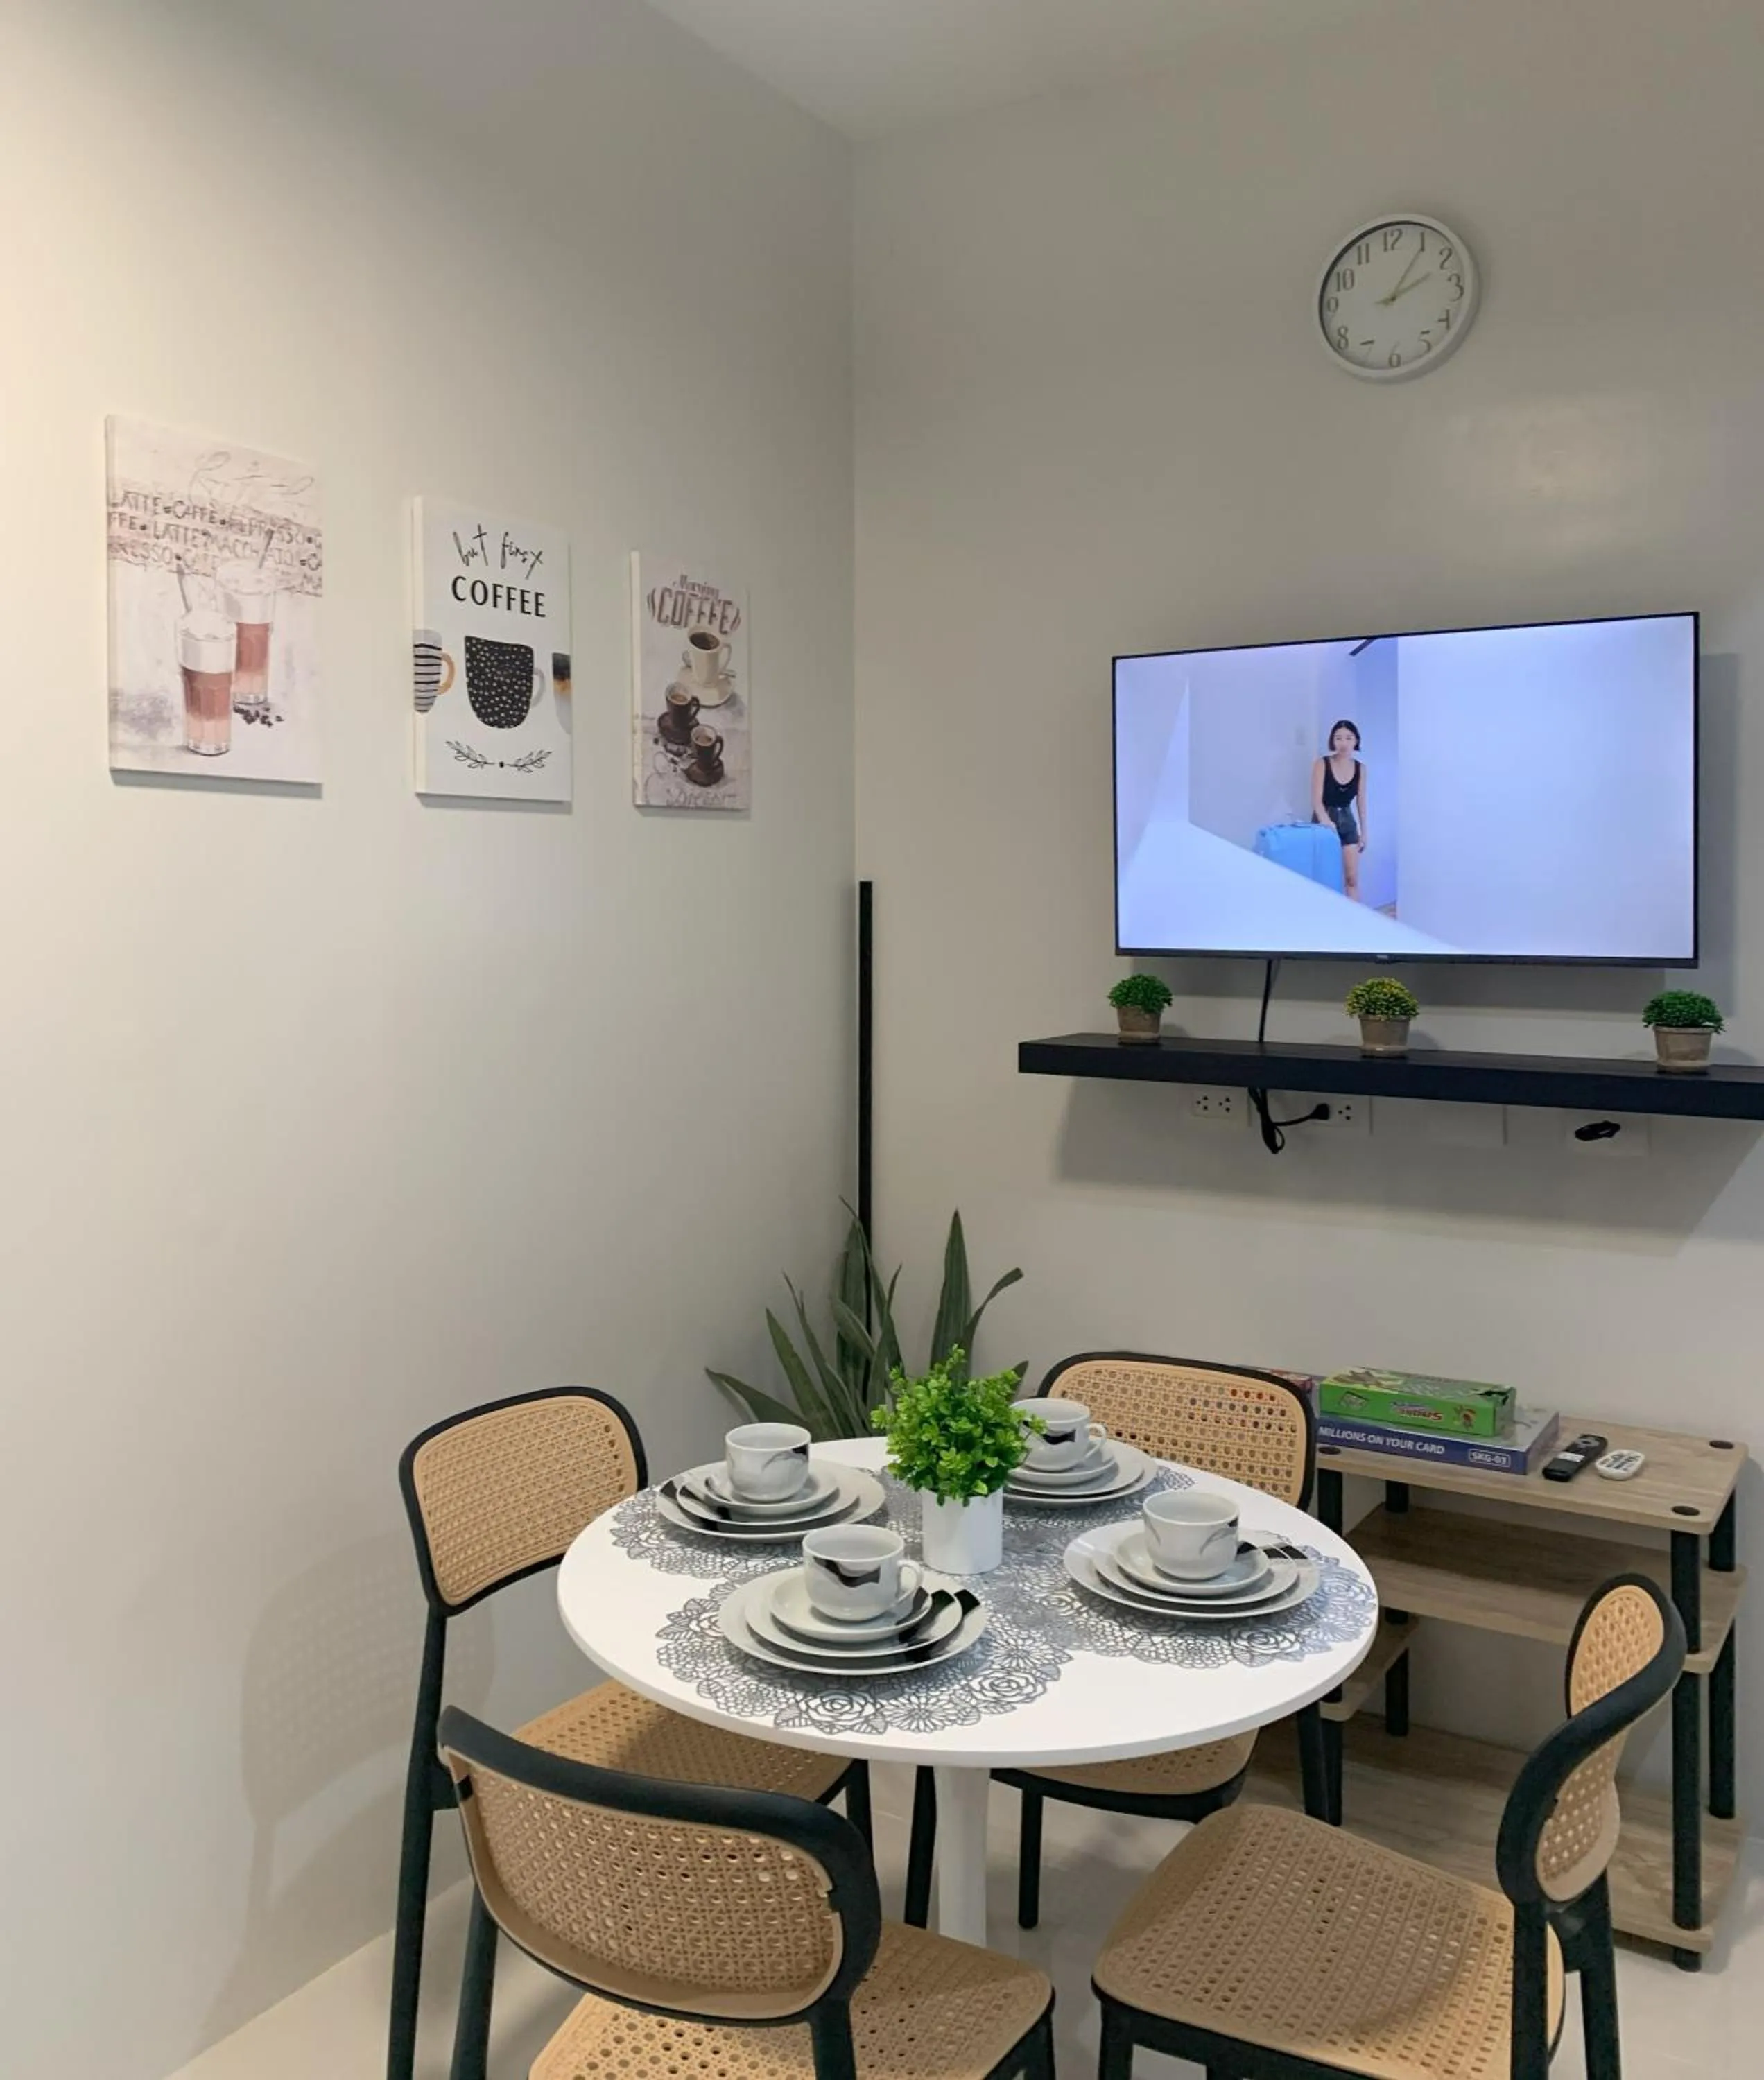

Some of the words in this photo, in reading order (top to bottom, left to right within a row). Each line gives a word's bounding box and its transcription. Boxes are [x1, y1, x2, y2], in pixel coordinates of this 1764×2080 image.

[1383, 229, 1403, 252] 12
[1420, 232, 1426, 252] 1
[1357, 243, 1369, 266] 11
[1439, 246, 1453, 270] 2
[1337, 268, 1355, 292] 10
[1448, 273, 1464, 302] 3
[1337, 326, 1349, 350] 8
[1419, 330, 1432, 353] 5
[452, 523, 488, 566] but
[451, 575, 546, 618] COFFEE
[1319, 1426, 1367, 1442] MILLIONS
[1367, 1435, 1384, 1445] ON
[1387, 1437, 1414, 1450] YOUR
[1416, 1441, 1445, 1455] CARD
